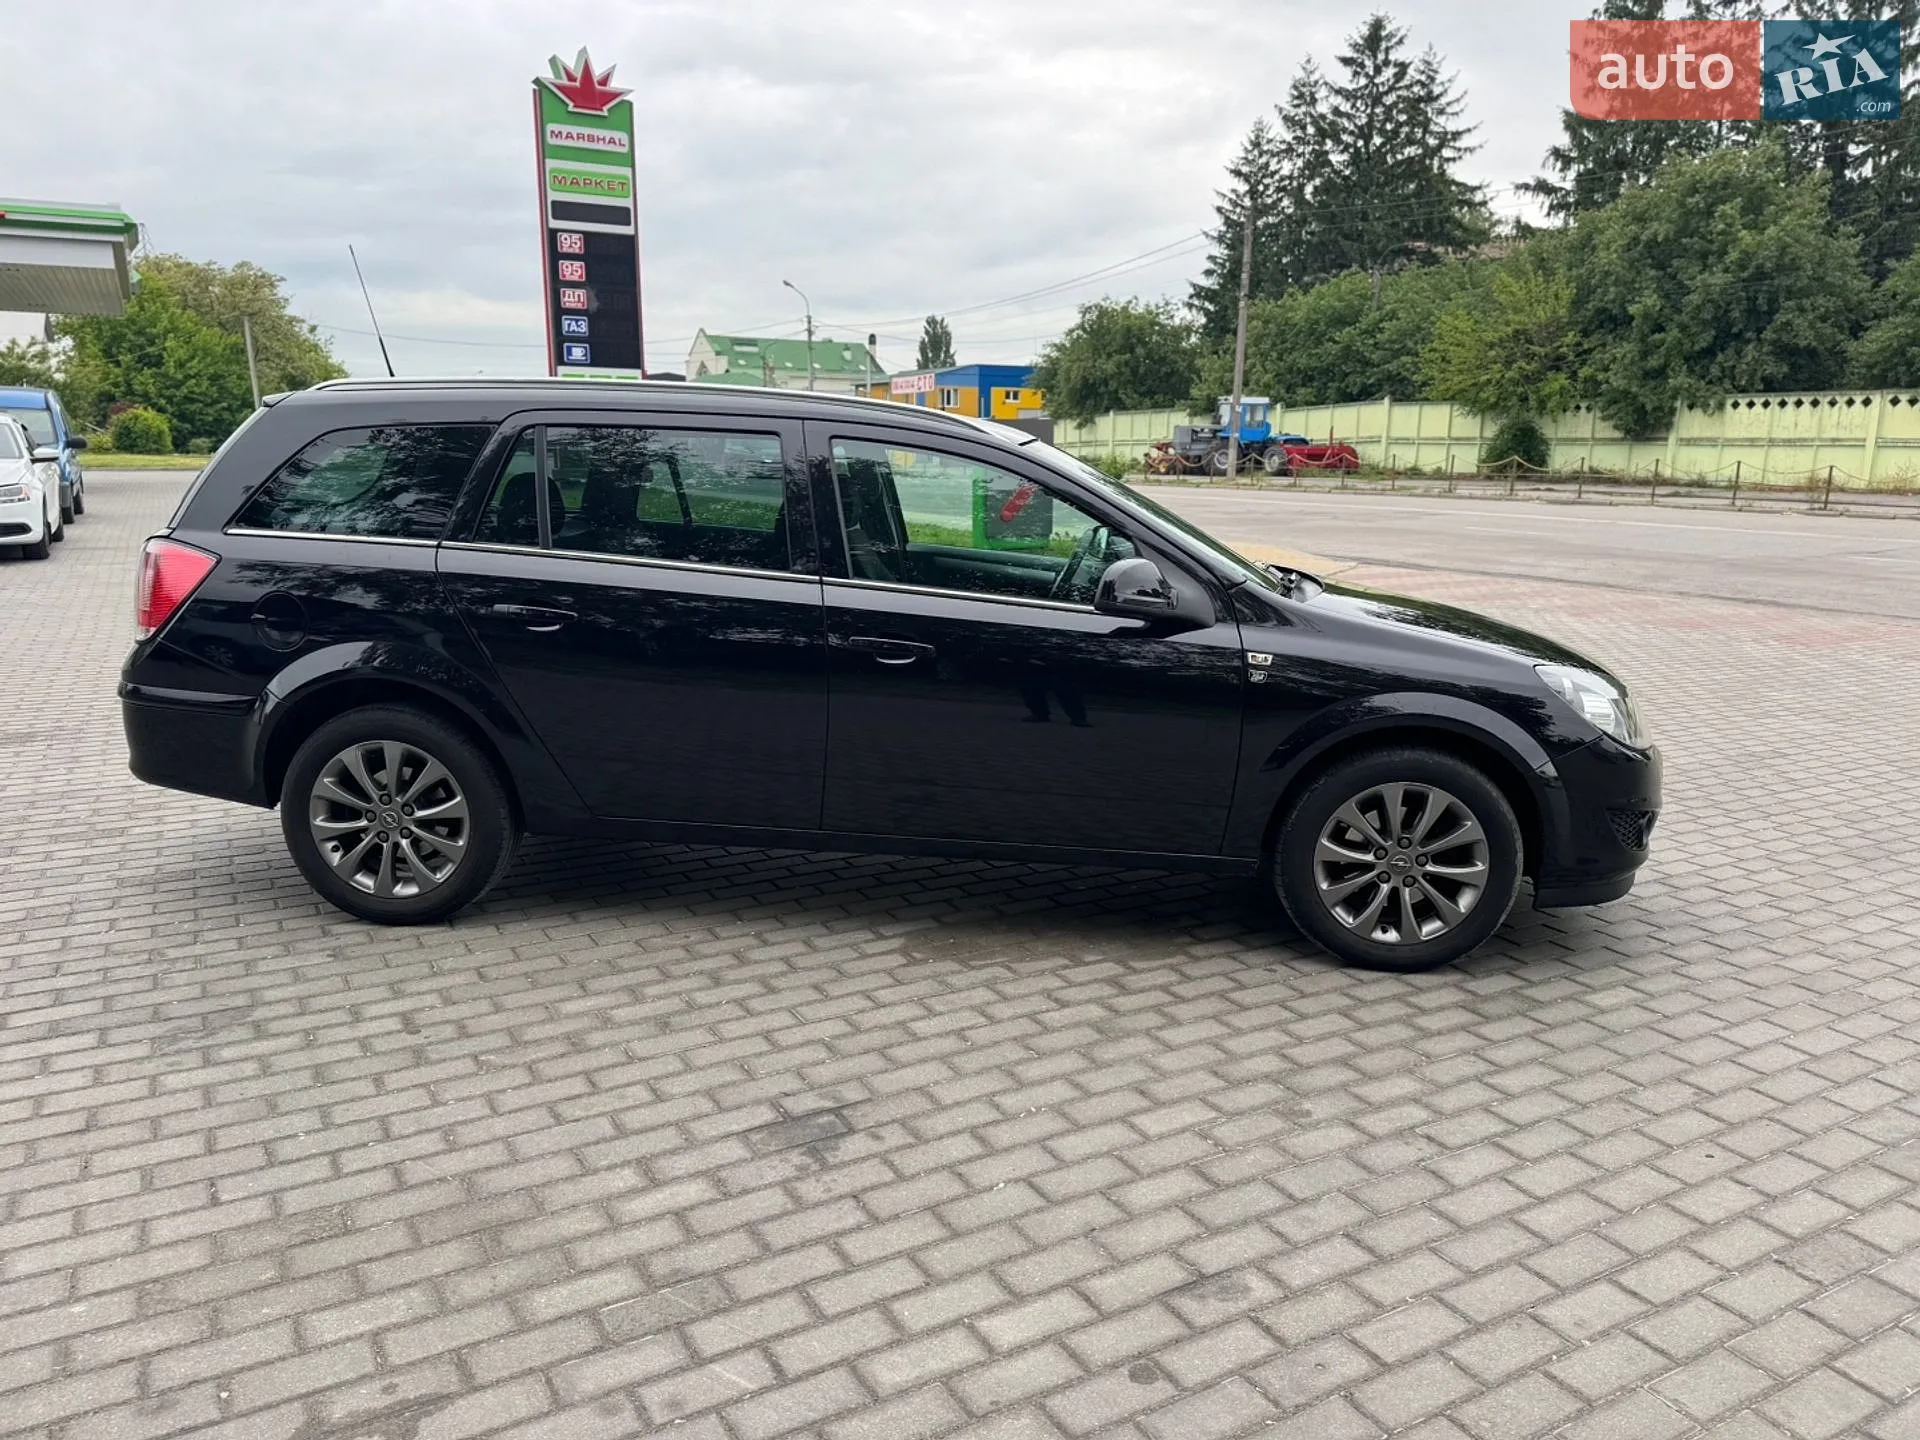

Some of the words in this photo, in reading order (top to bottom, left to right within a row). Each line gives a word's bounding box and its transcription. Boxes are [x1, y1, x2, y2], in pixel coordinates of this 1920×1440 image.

[560, 233, 581, 248] 95
[562, 263, 581, 276] 95
[564, 290, 584, 302] ДП
[564, 319, 586, 333] ГАЗ
[916, 375, 933, 391] СТО
